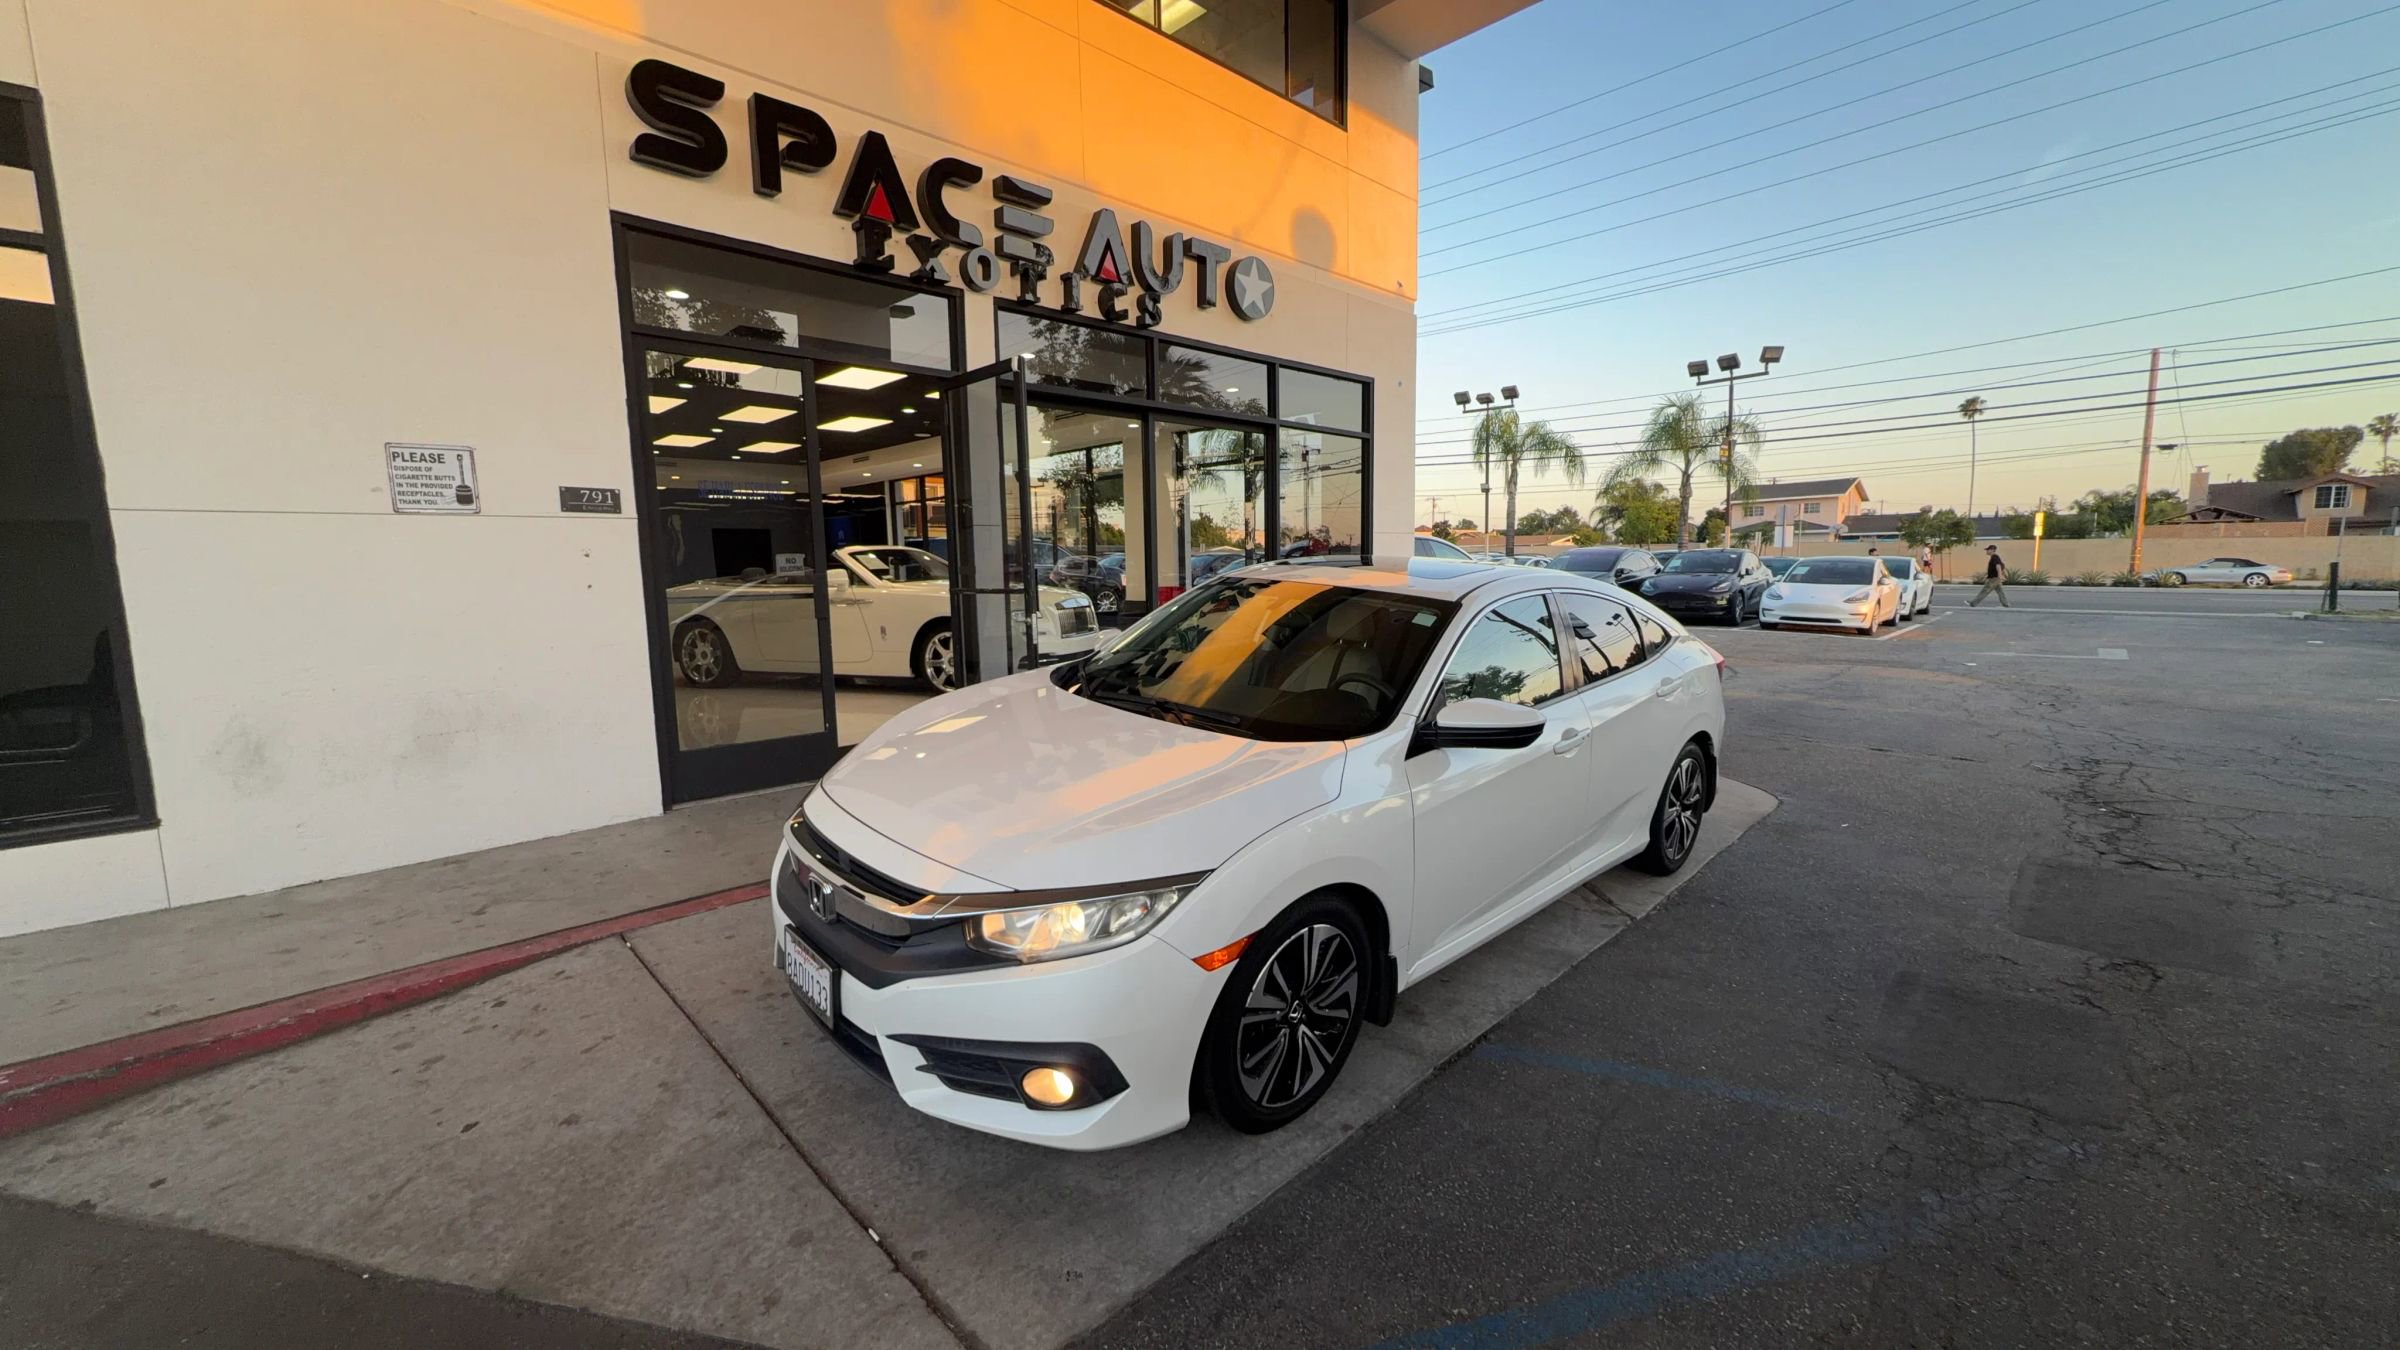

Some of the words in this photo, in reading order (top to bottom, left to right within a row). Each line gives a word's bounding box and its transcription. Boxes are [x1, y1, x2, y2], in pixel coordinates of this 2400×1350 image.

[625, 58, 1055, 268] SPACE
[1073, 207, 1276, 323] AUTO
[391, 451, 446, 464] PLEASE
[580, 490, 614, 504] 791
